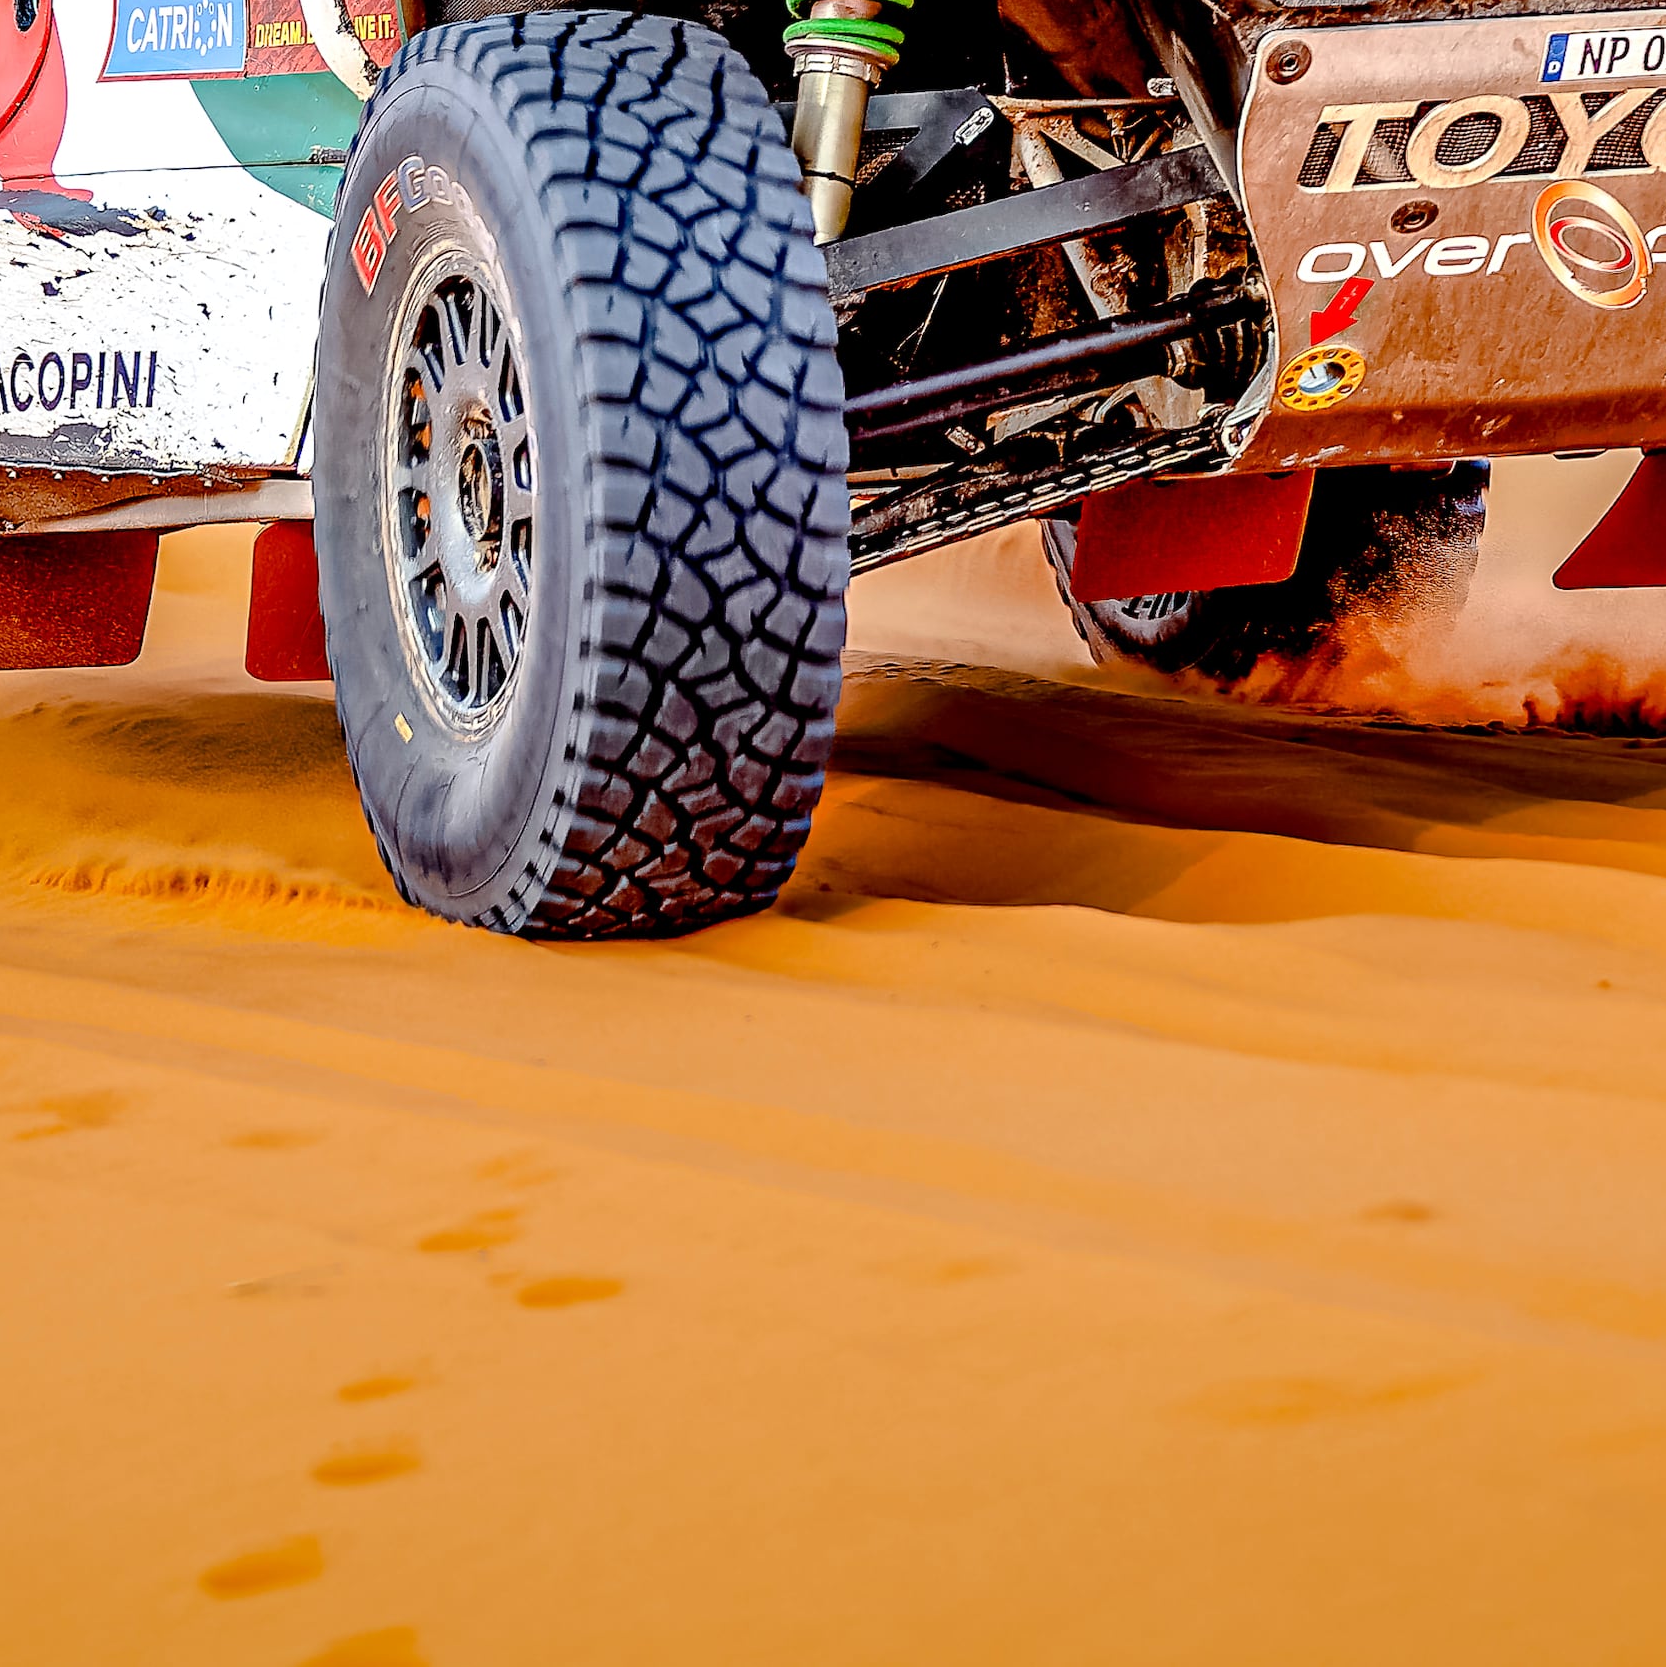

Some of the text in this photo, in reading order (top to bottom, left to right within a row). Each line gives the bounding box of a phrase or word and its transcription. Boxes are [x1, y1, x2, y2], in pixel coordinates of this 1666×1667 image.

[354, 14, 377, 41] IVE
[1578, 36, 1631, 75] NP
[1296, 230, 1531, 284] over
